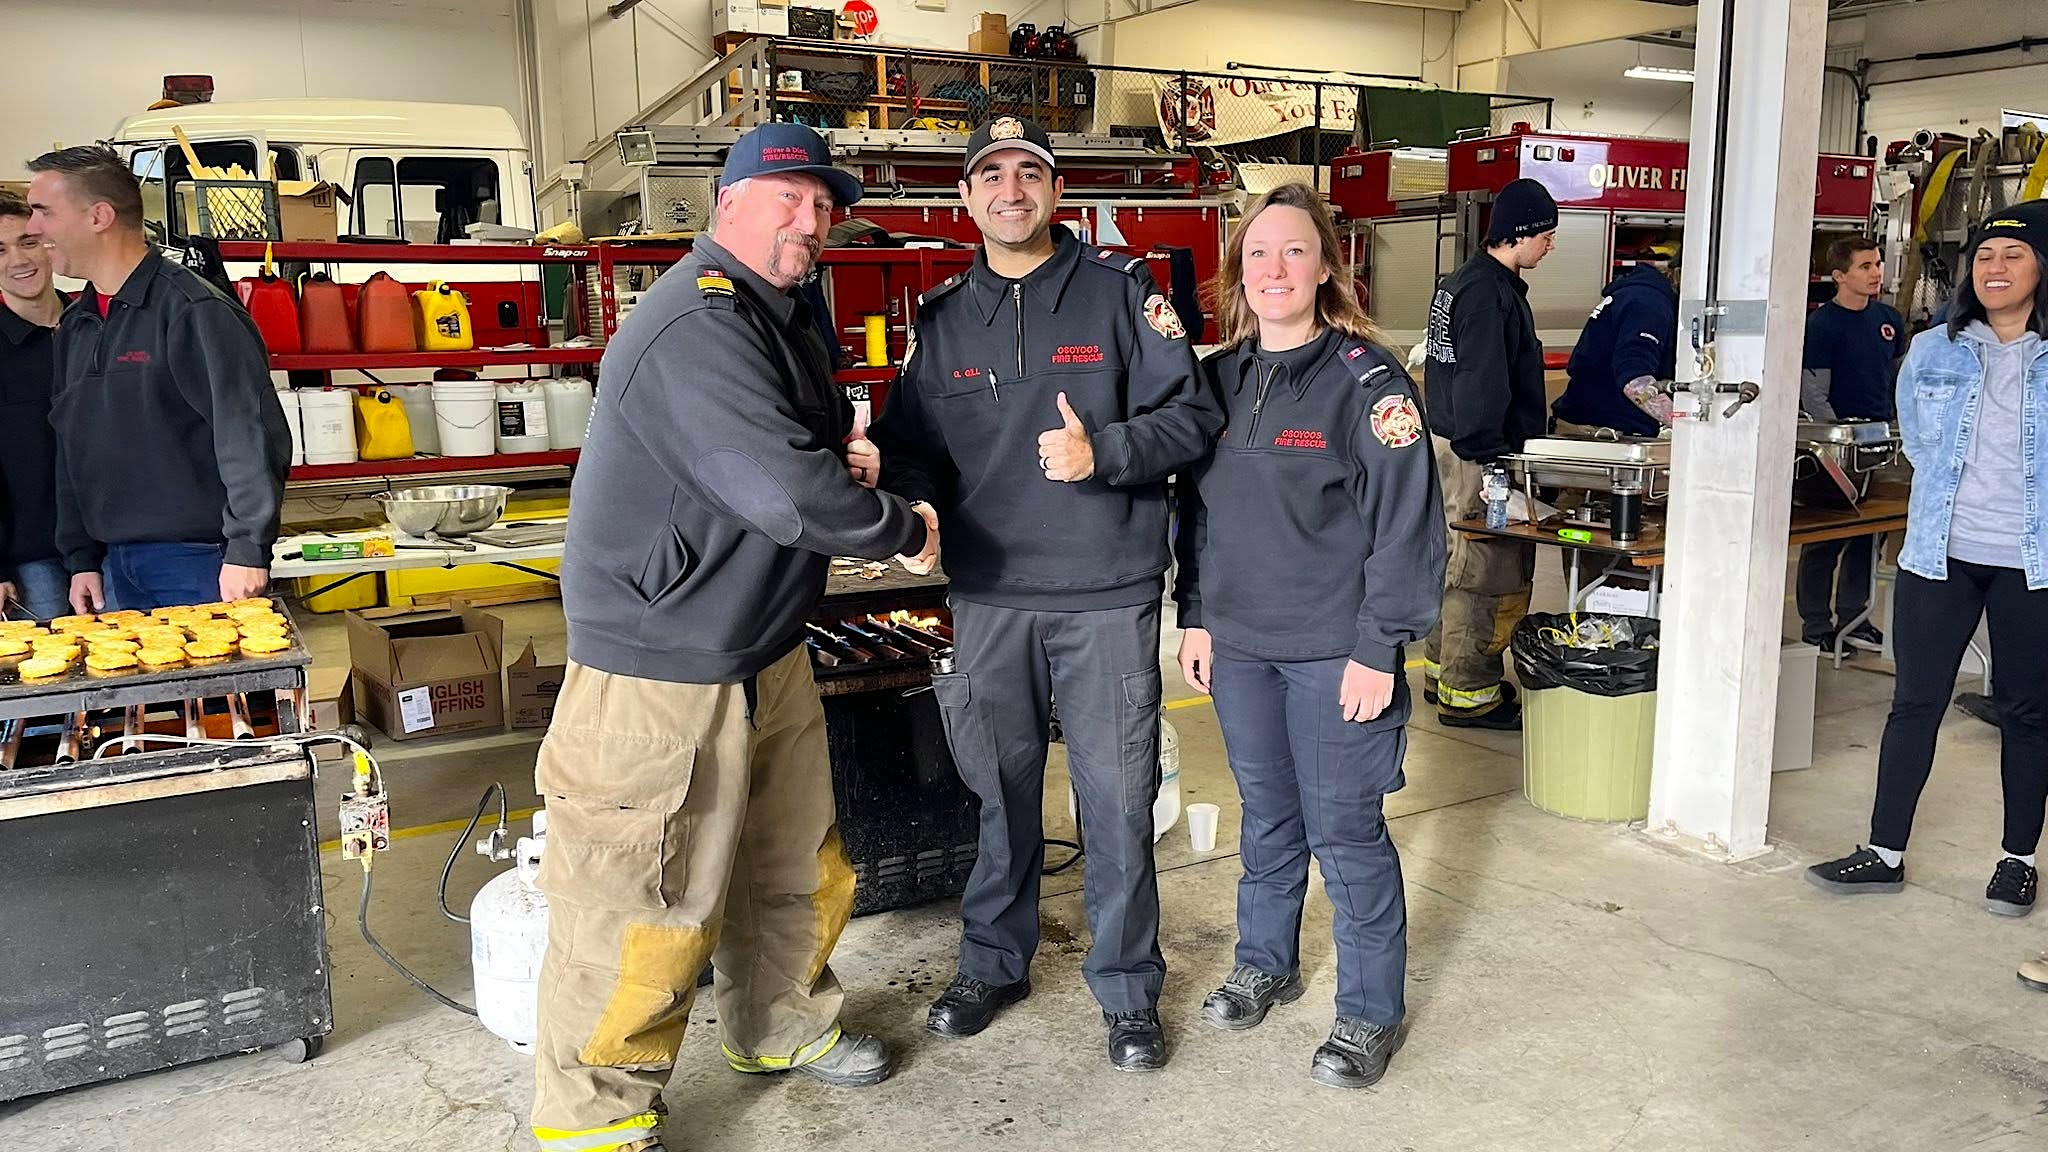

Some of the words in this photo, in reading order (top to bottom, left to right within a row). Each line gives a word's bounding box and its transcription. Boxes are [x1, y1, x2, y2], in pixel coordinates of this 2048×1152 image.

[853, 10, 874, 24] TOP
[1331, 99, 1356, 120] Fa
[1589, 163, 1662, 190] OLIVER
[1670, 168, 1687, 191] FI
[543, 248, 588, 258] Snap-on
[1145, 251, 1170, 260] Snap-o
[1057, 345, 1099, 355] OSOYOOS
[1052, 355, 1071, 364] FIRE
[1072, 353, 1103, 363] RESCUE
[1282, 430, 1322, 440] OSOYOOS
[1275, 438, 1293, 446] FIRE
[1294, 439, 1327, 449] RESCUE
[429, 680, 484, 699] NGLISH
[431, 695, 485, 717] UFFINS
